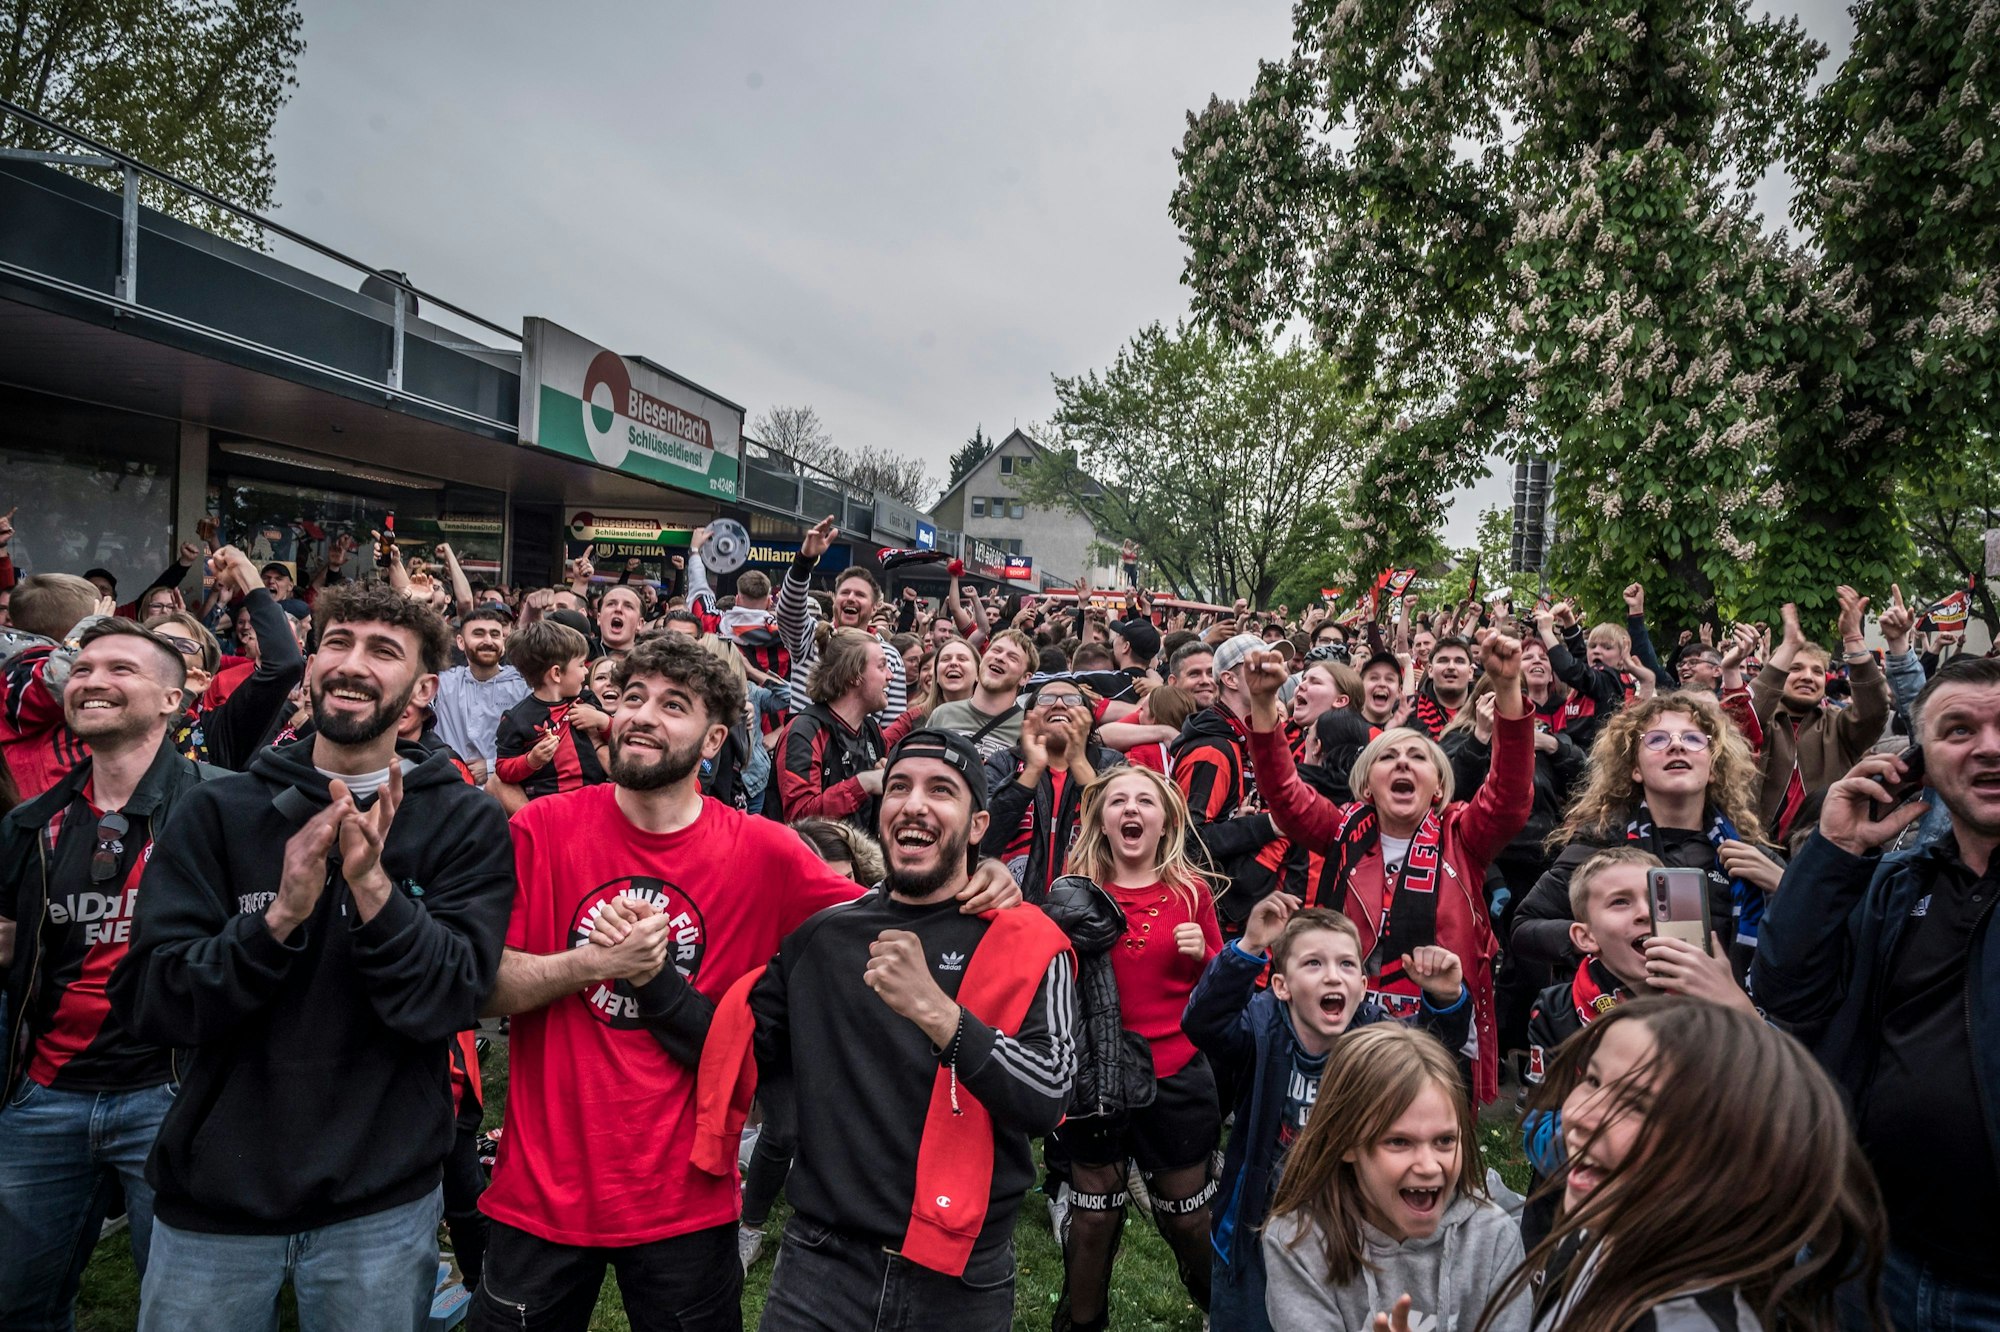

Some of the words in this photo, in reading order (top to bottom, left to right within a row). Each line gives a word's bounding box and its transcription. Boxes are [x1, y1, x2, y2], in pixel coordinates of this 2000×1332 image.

[627, 388, 707, 446] Biesenbach
[628, 425, 703, 467] Schlüsseldienst
[716, 477, 736, 496] 42461
[591, 517, 658, 529] Biesenbach
[594, 528, 654, 538] Schlüsseldienst
[747, 546, 796, 563] Allianz
[1011, 557, 1026, 567] sky
[1009, 569, 1026, 577] sport
[669, 911, 699, 961] FÜR
[939, 963, 962, 971] adidas
[1077, 1193, 1107, 1210] MUSIC
[1179, 1191, 1205, 1213] LOVE
